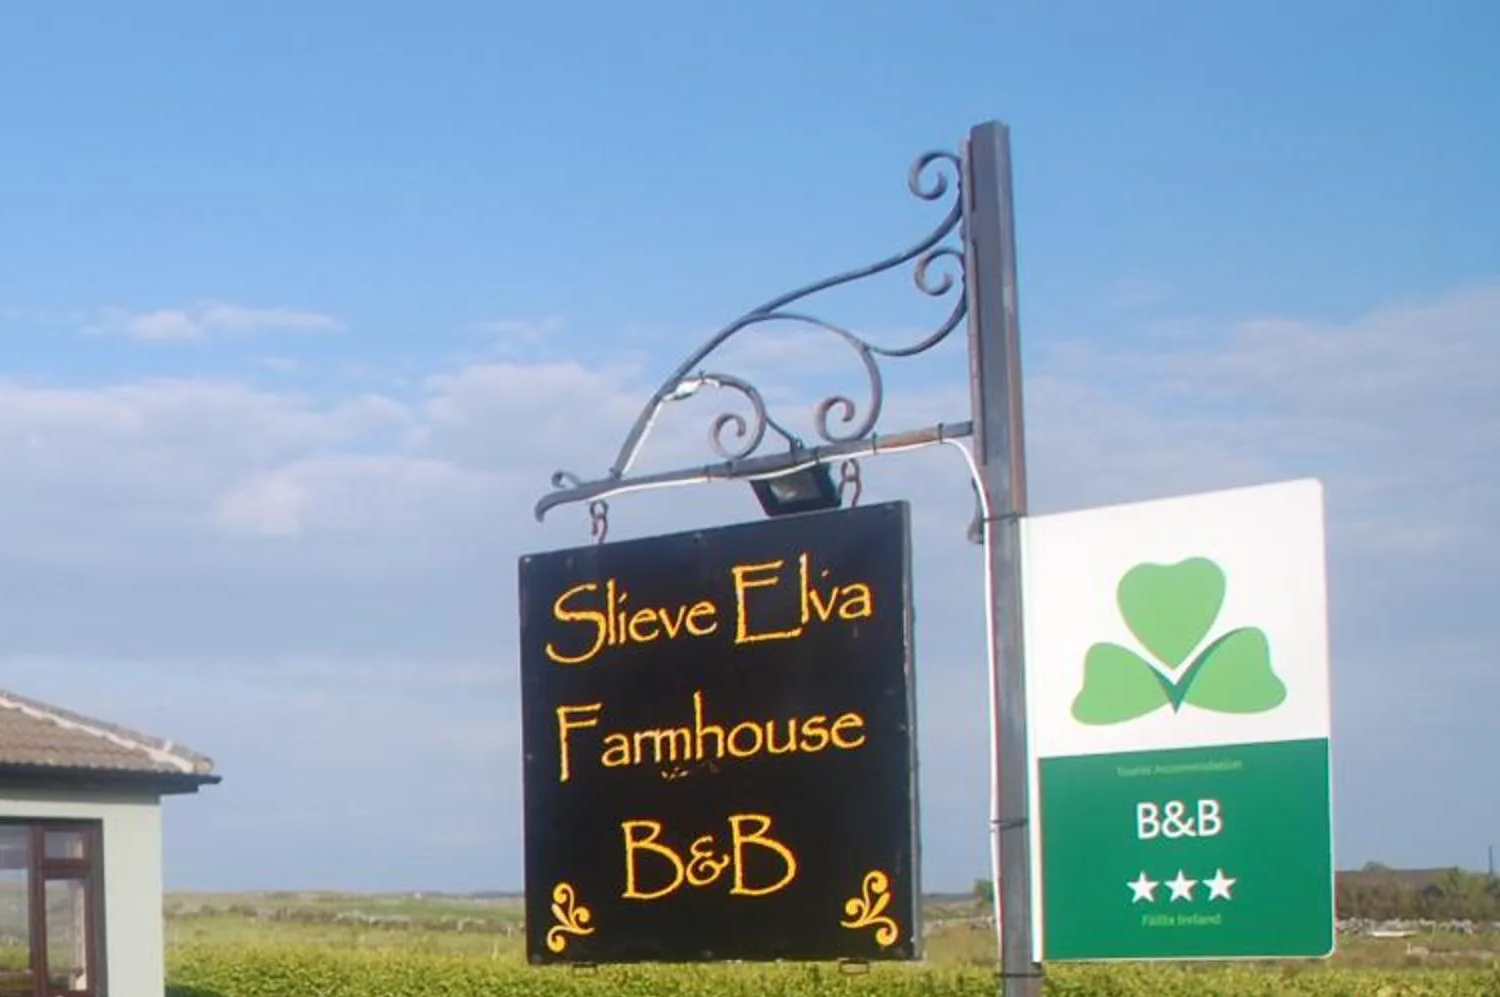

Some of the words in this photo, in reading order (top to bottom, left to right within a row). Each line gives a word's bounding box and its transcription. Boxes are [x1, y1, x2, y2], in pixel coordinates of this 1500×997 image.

[545, 577, 718, 664] Slieve
[732, 552, 872, 644] Elva
[555, 691, 867, 783] Farmhouse
[621, 814, 797, 900] B&B
[1136, 799, 1222, 839] B&B
